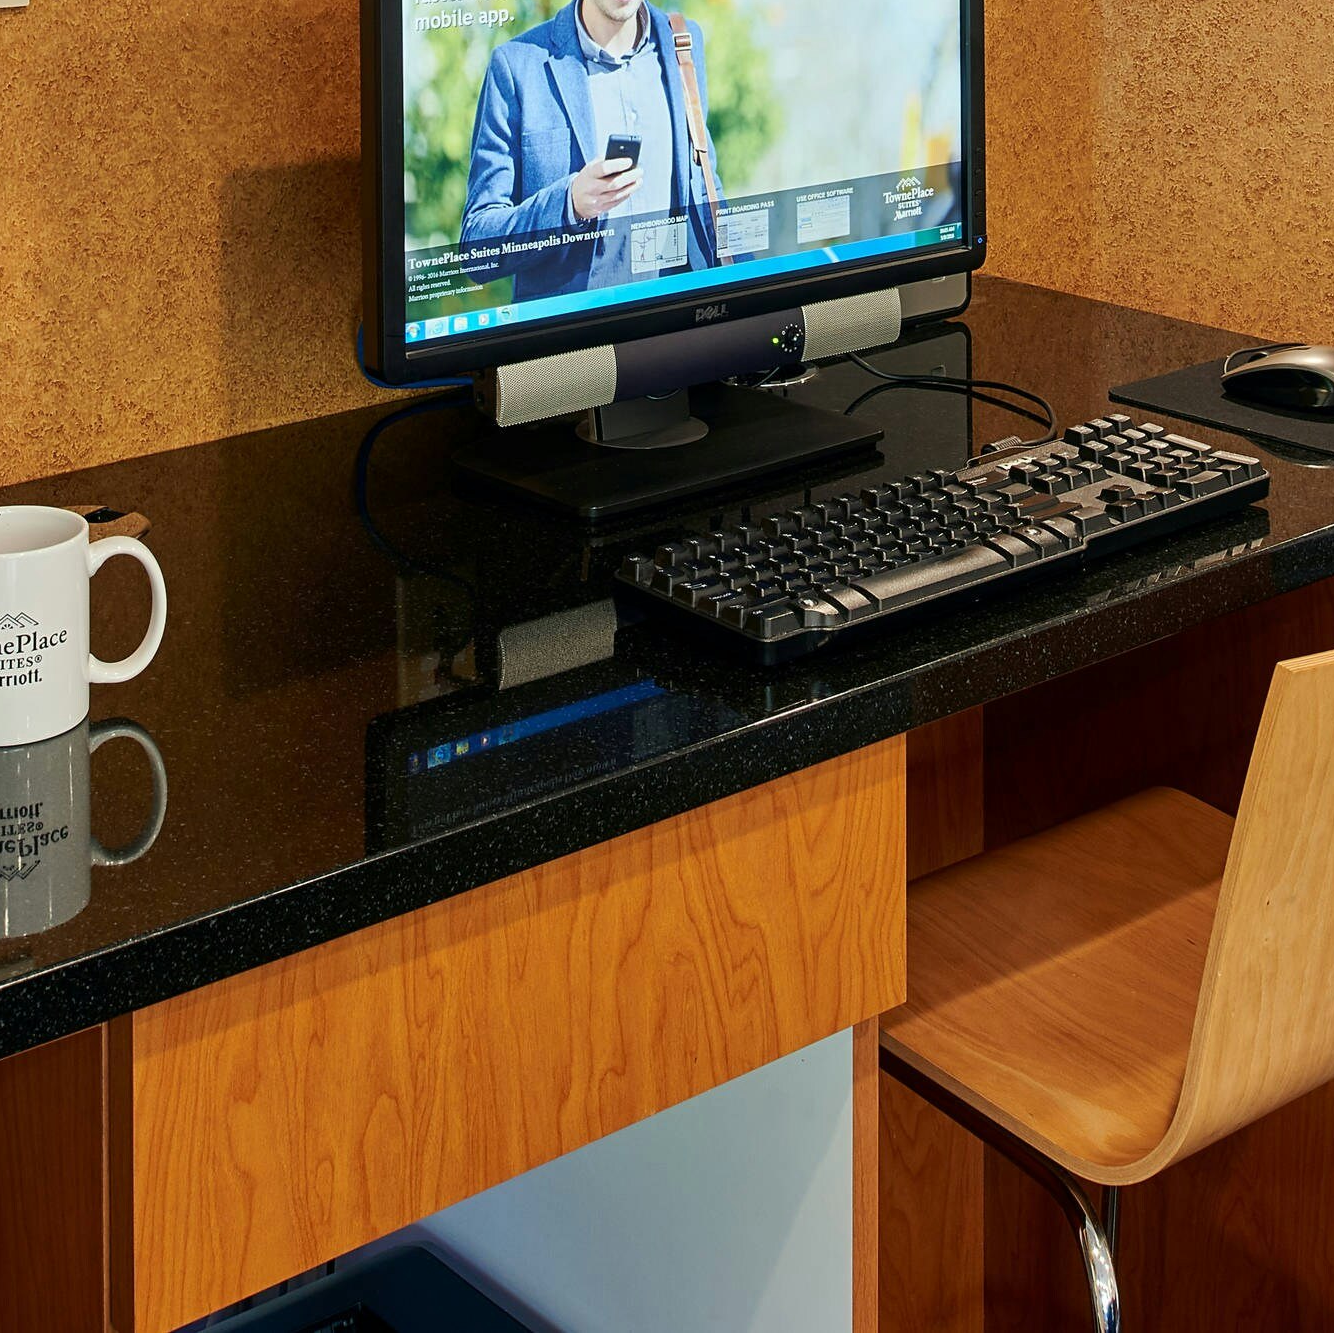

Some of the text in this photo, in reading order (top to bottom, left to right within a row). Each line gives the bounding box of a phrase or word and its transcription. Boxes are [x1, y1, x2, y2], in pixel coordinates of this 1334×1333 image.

[415, 9, 515, 31] mobile app.
[808, 192, 826, 201] OFFICE
[826, 187, 853, 198] SOFTWARE
[883, 187, 934, 204] TownePlace
[715, 200, 775, 216] PRINT BOARDING PASS
[631, 215, 688, 230] NEIGHBORHOOD MAP
[408, 227, 615, 270] TownePlace Suites Minneapolis Downtown
[695, 304, 729, 323] DELL
